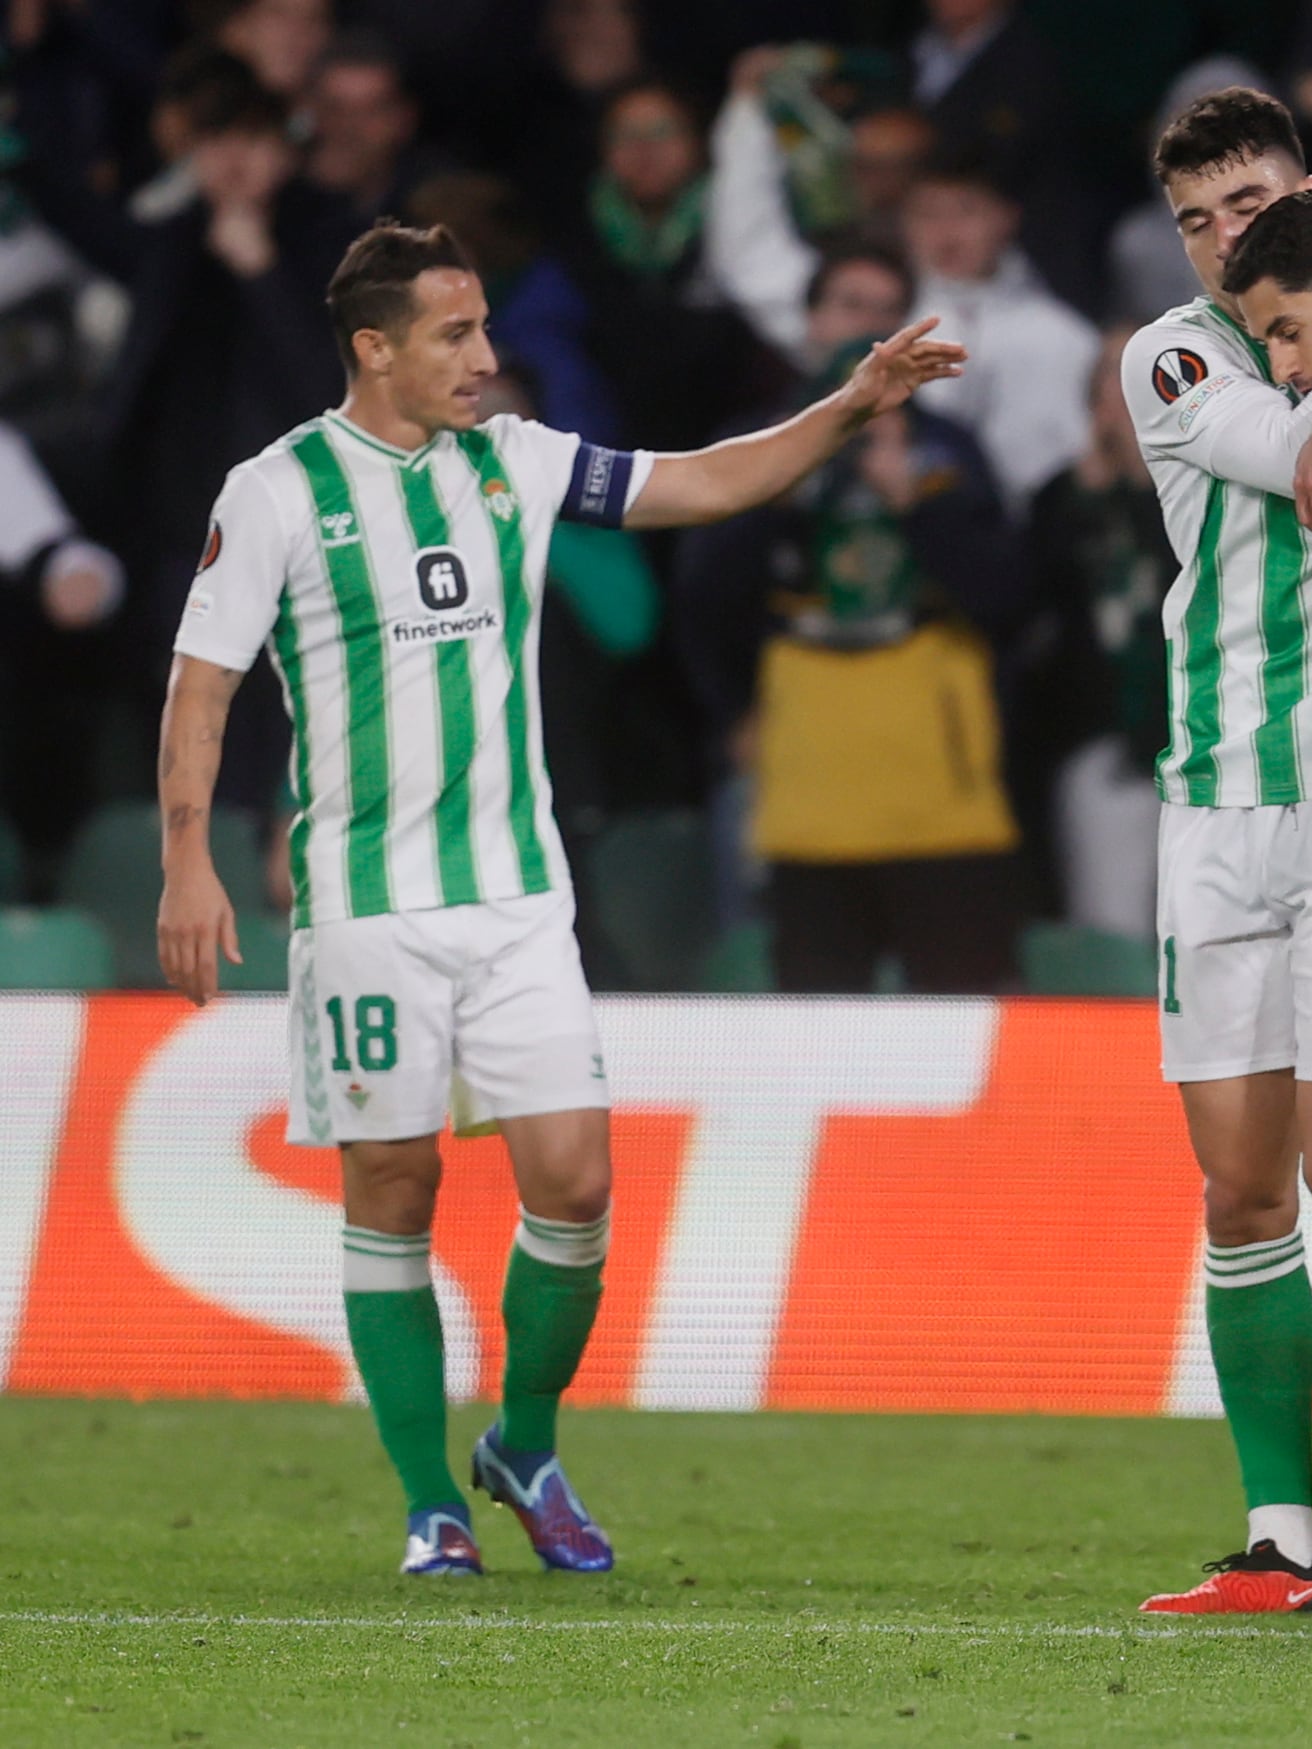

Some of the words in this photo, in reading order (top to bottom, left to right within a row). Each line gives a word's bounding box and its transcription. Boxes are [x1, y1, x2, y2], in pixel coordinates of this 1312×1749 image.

[428, 561, 458, 600] fi
[393, 608, 497, 642] finetwork
[326, 993, 398, 1072] 18
[0, 996, 1004, 1411] ST
